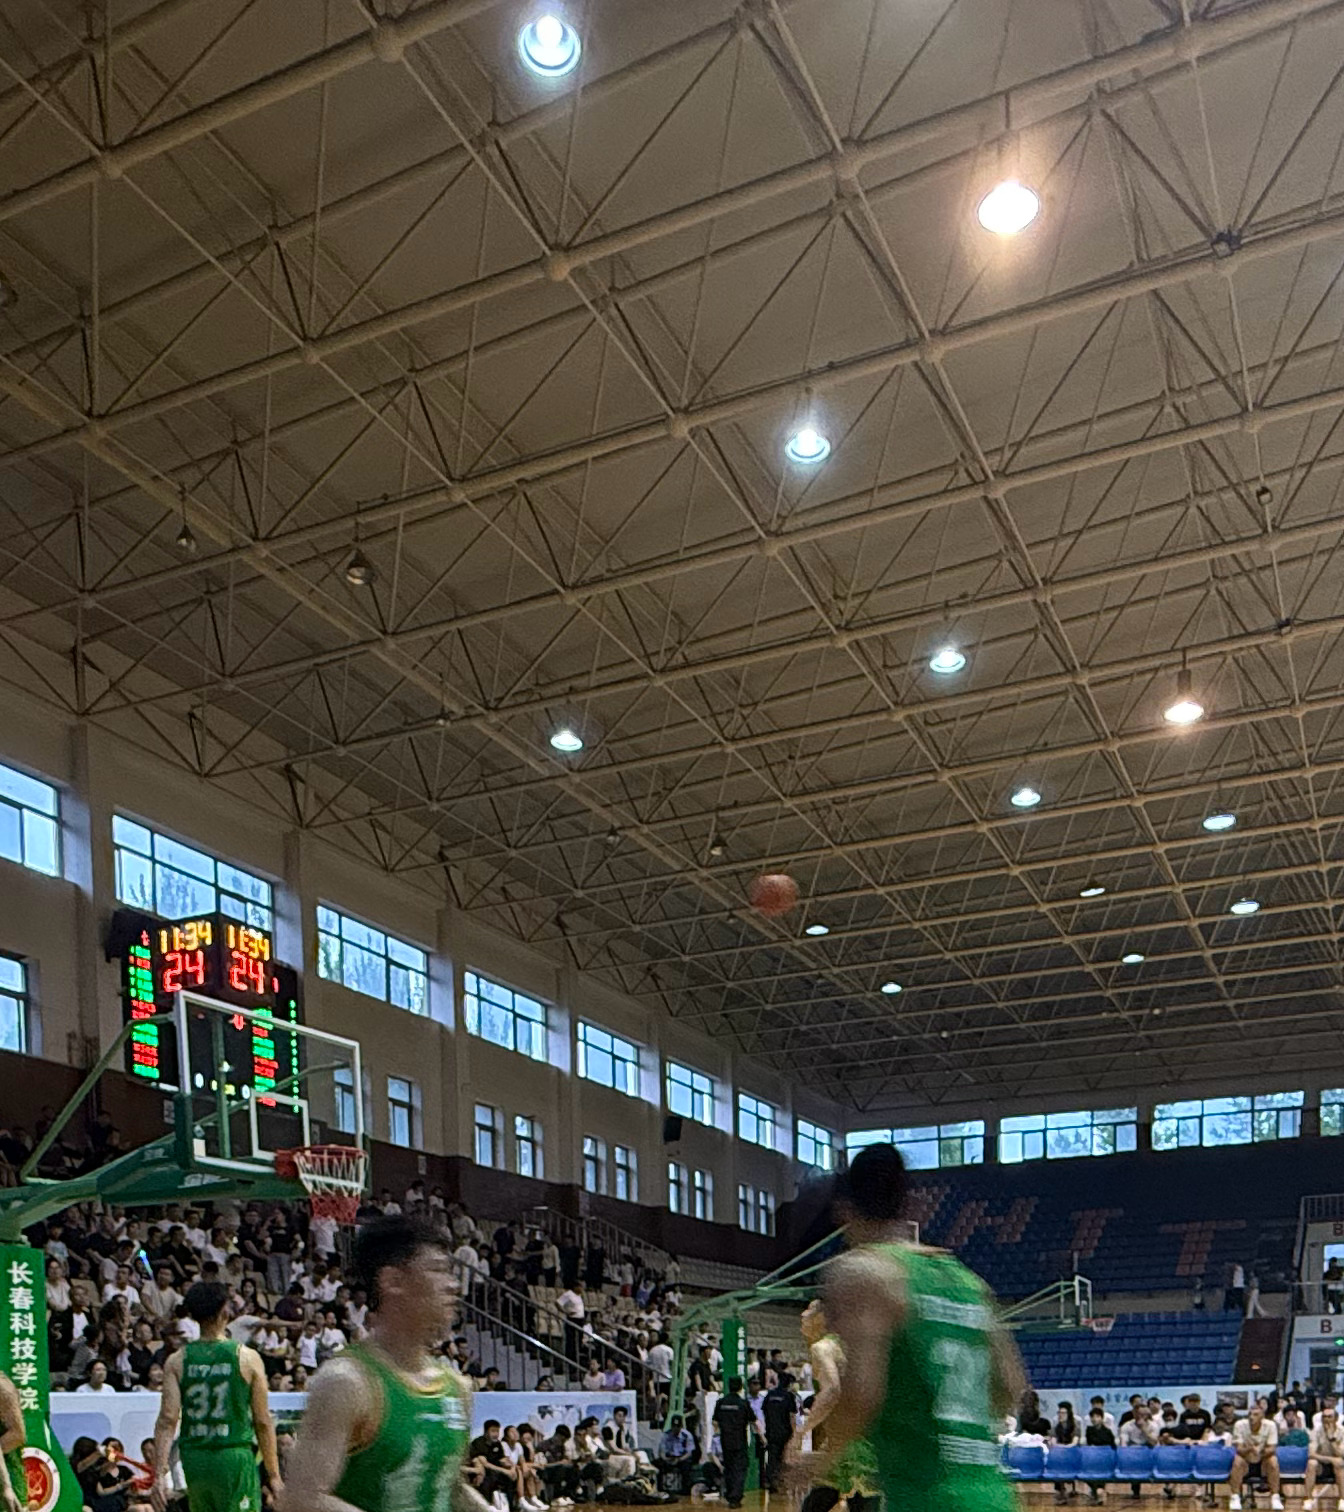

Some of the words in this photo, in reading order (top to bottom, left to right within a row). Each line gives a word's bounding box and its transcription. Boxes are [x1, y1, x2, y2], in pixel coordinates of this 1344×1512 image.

[160, 921, 212, 954] 11:34
[163, 950, 204, 992] 24
[230, 950, 265, 994] 24
[1333, 1223, 1344, 1236] B
[8, 1261, 40, 1410] 长春科技学院
[1320, 1319, 1333, 1333] B
[186, 1381, 230, 1419] 31
